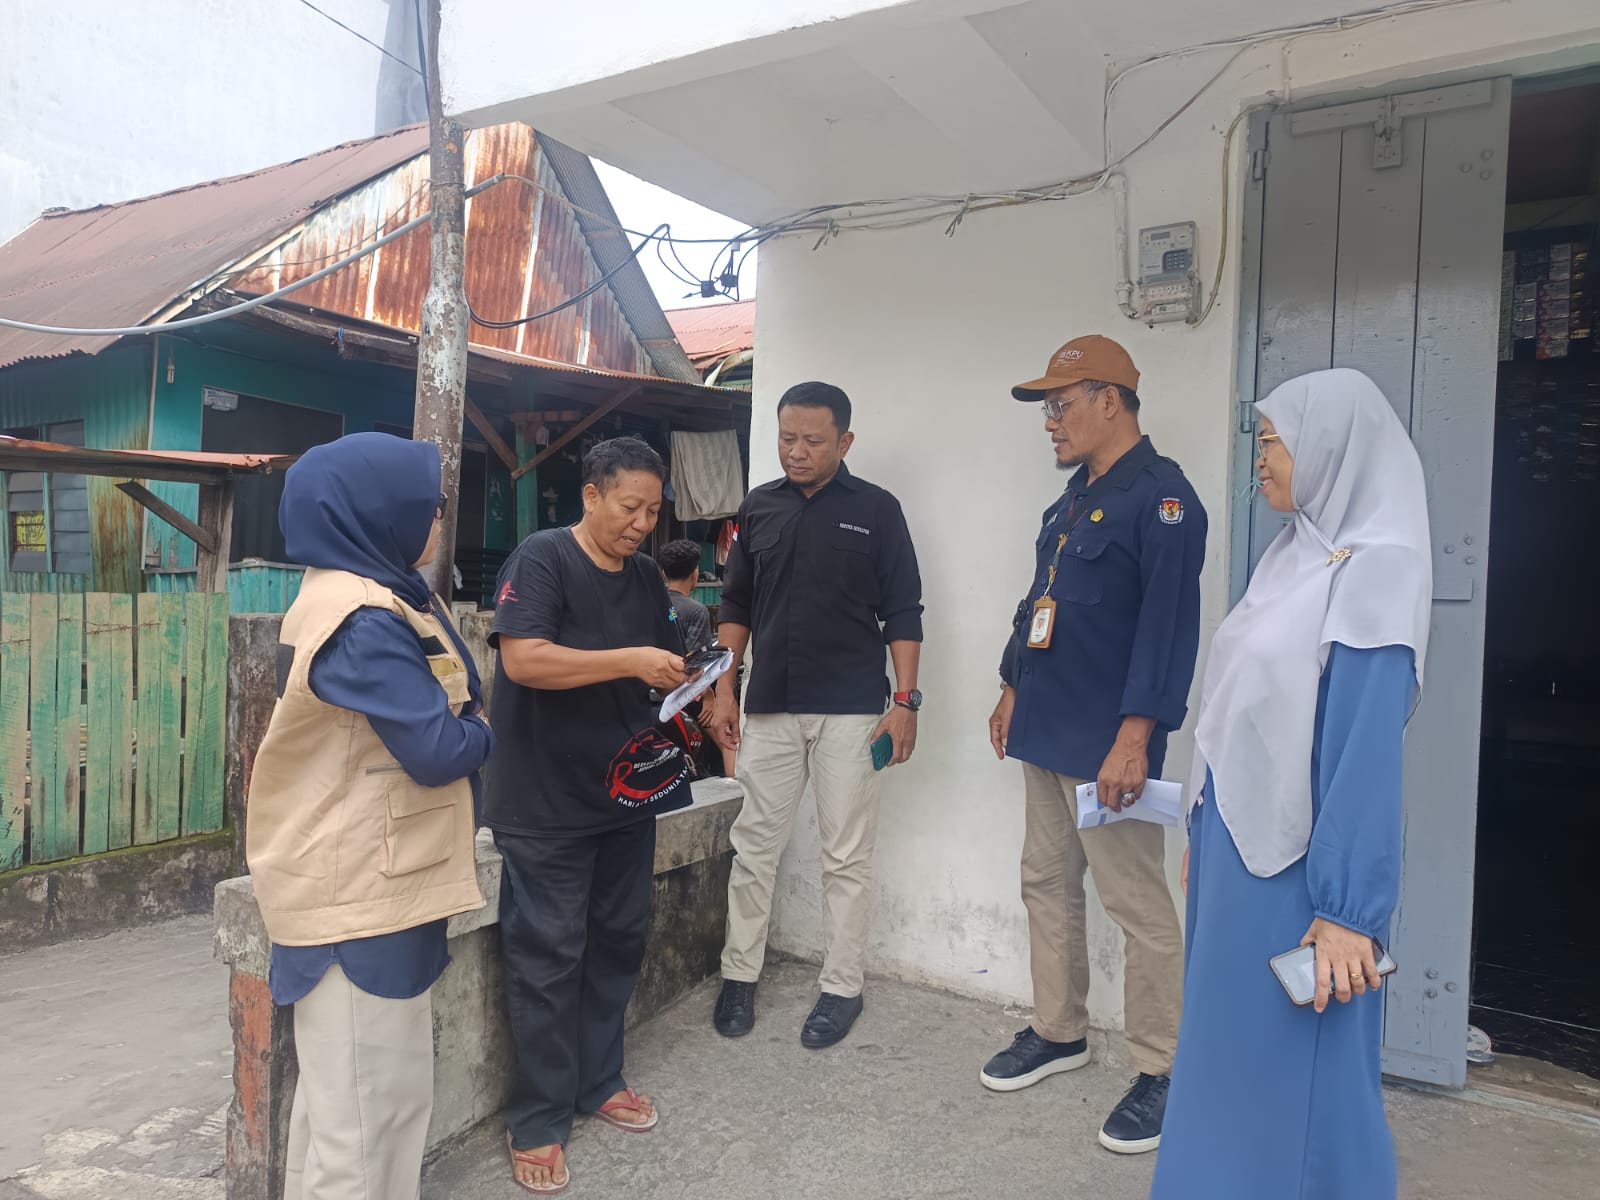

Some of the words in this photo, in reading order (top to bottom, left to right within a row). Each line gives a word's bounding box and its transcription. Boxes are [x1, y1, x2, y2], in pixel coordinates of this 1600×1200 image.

[1066, 350, 1084, 358] KPU
[618, 796, 634, 808] HARI
[649, 779, 681, 802] SEDUNIA
